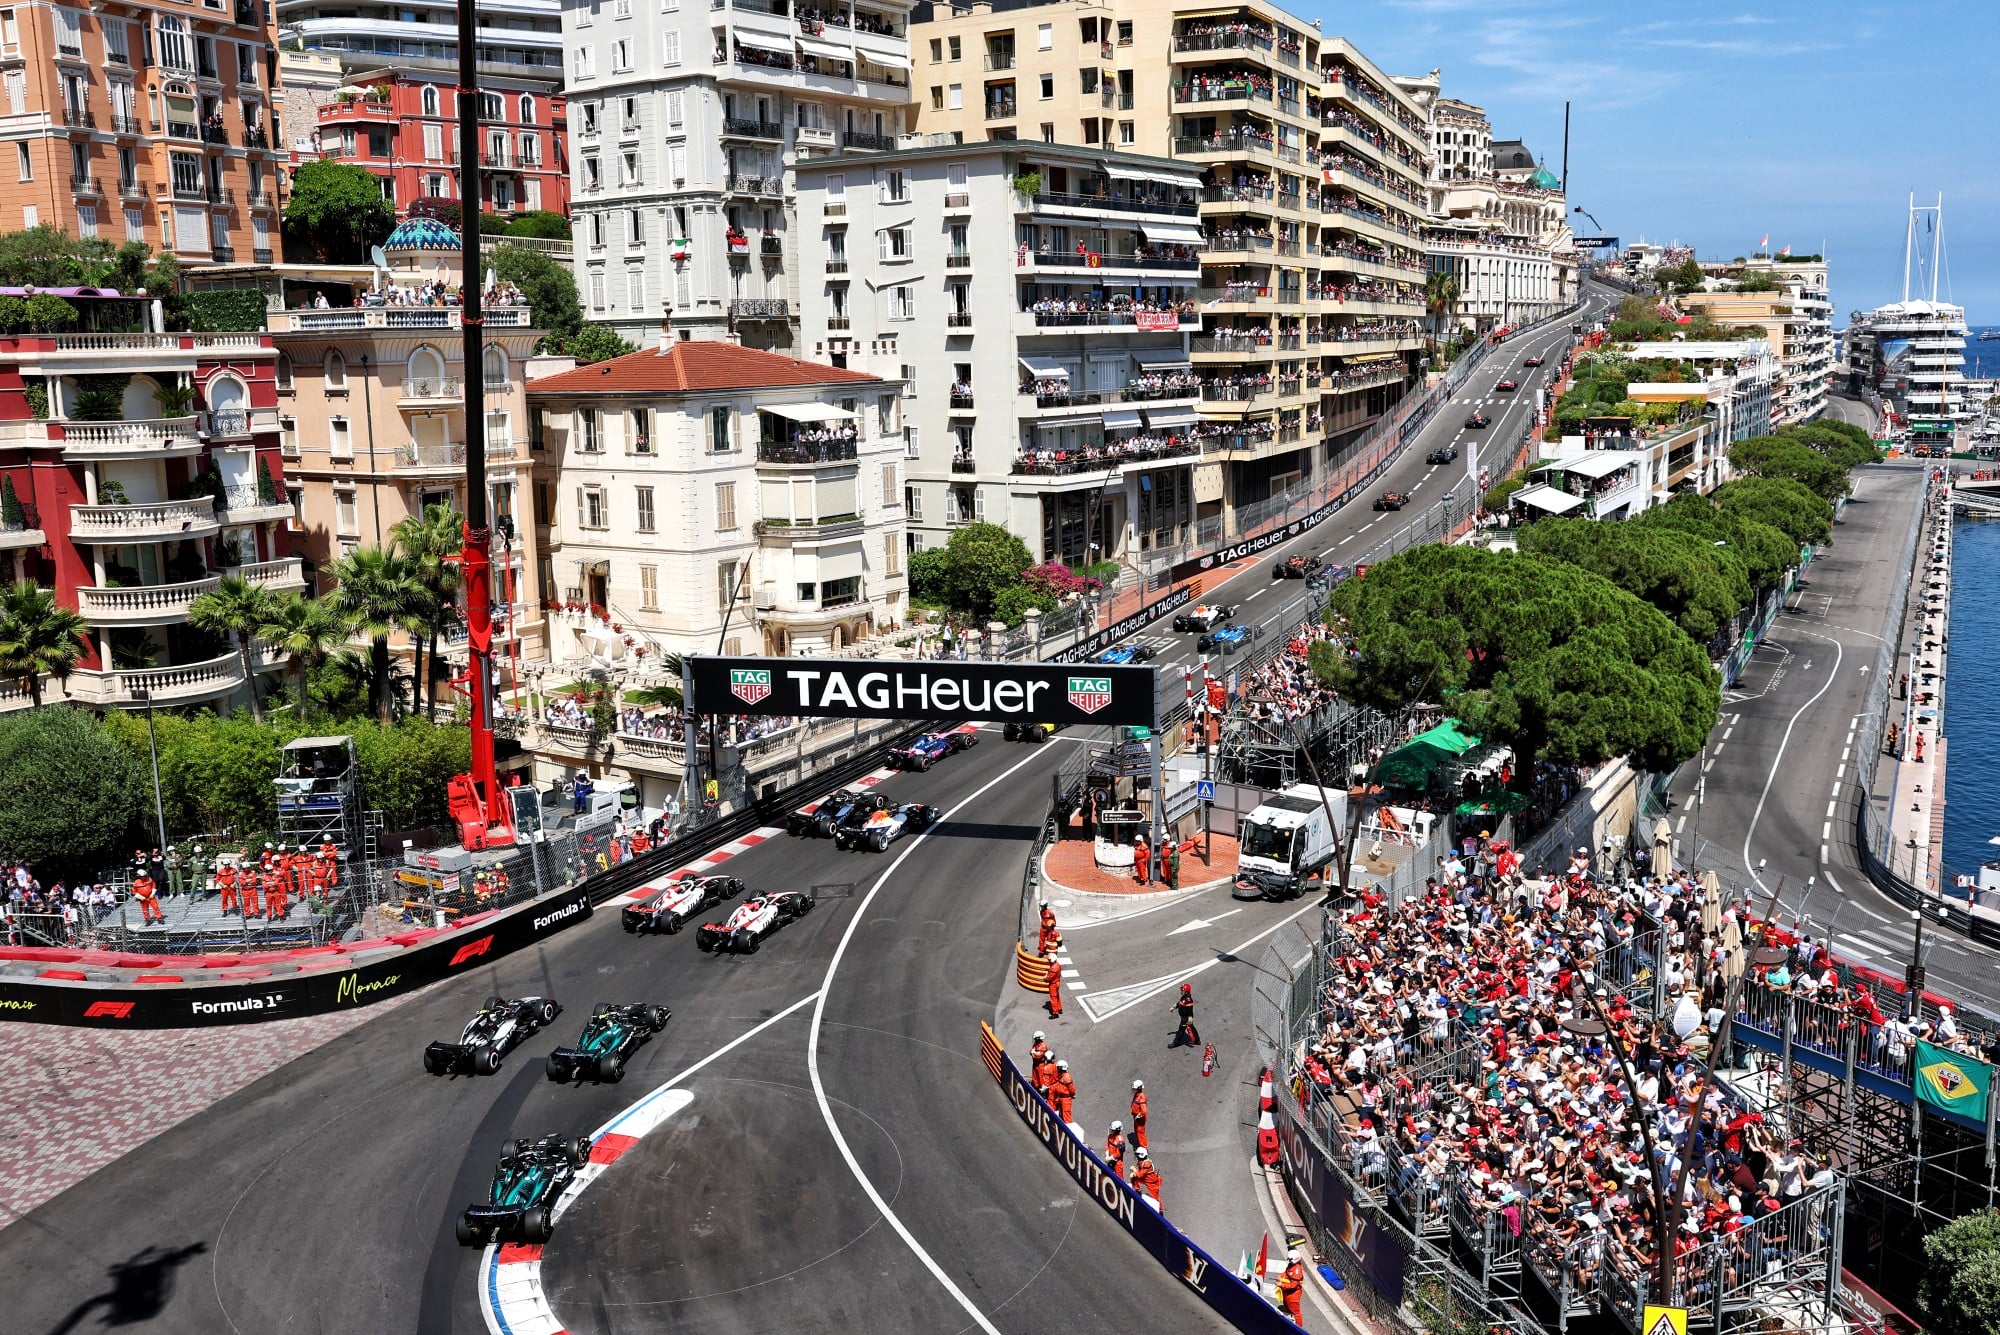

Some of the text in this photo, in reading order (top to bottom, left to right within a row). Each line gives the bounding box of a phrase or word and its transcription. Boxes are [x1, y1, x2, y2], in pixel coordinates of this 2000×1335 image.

[1216, 529, 1287, 563] TAGHeuer
[733, 671, 767, 684] TAG
[1071, 679, 1109, 692] TAG
[733, 685, 769, 701] HEUER
[786, 670, 1050, 714] TAGHeuer
[1070, 693, 1111, 712] HEUER
[533, 904, 579, 931] Formula
[337, 972, 401, 1004] Monaco
[191, 997, 264, 1014] Formula
[1010, 1071, 1134, 1231] LOUIS VUITTON
